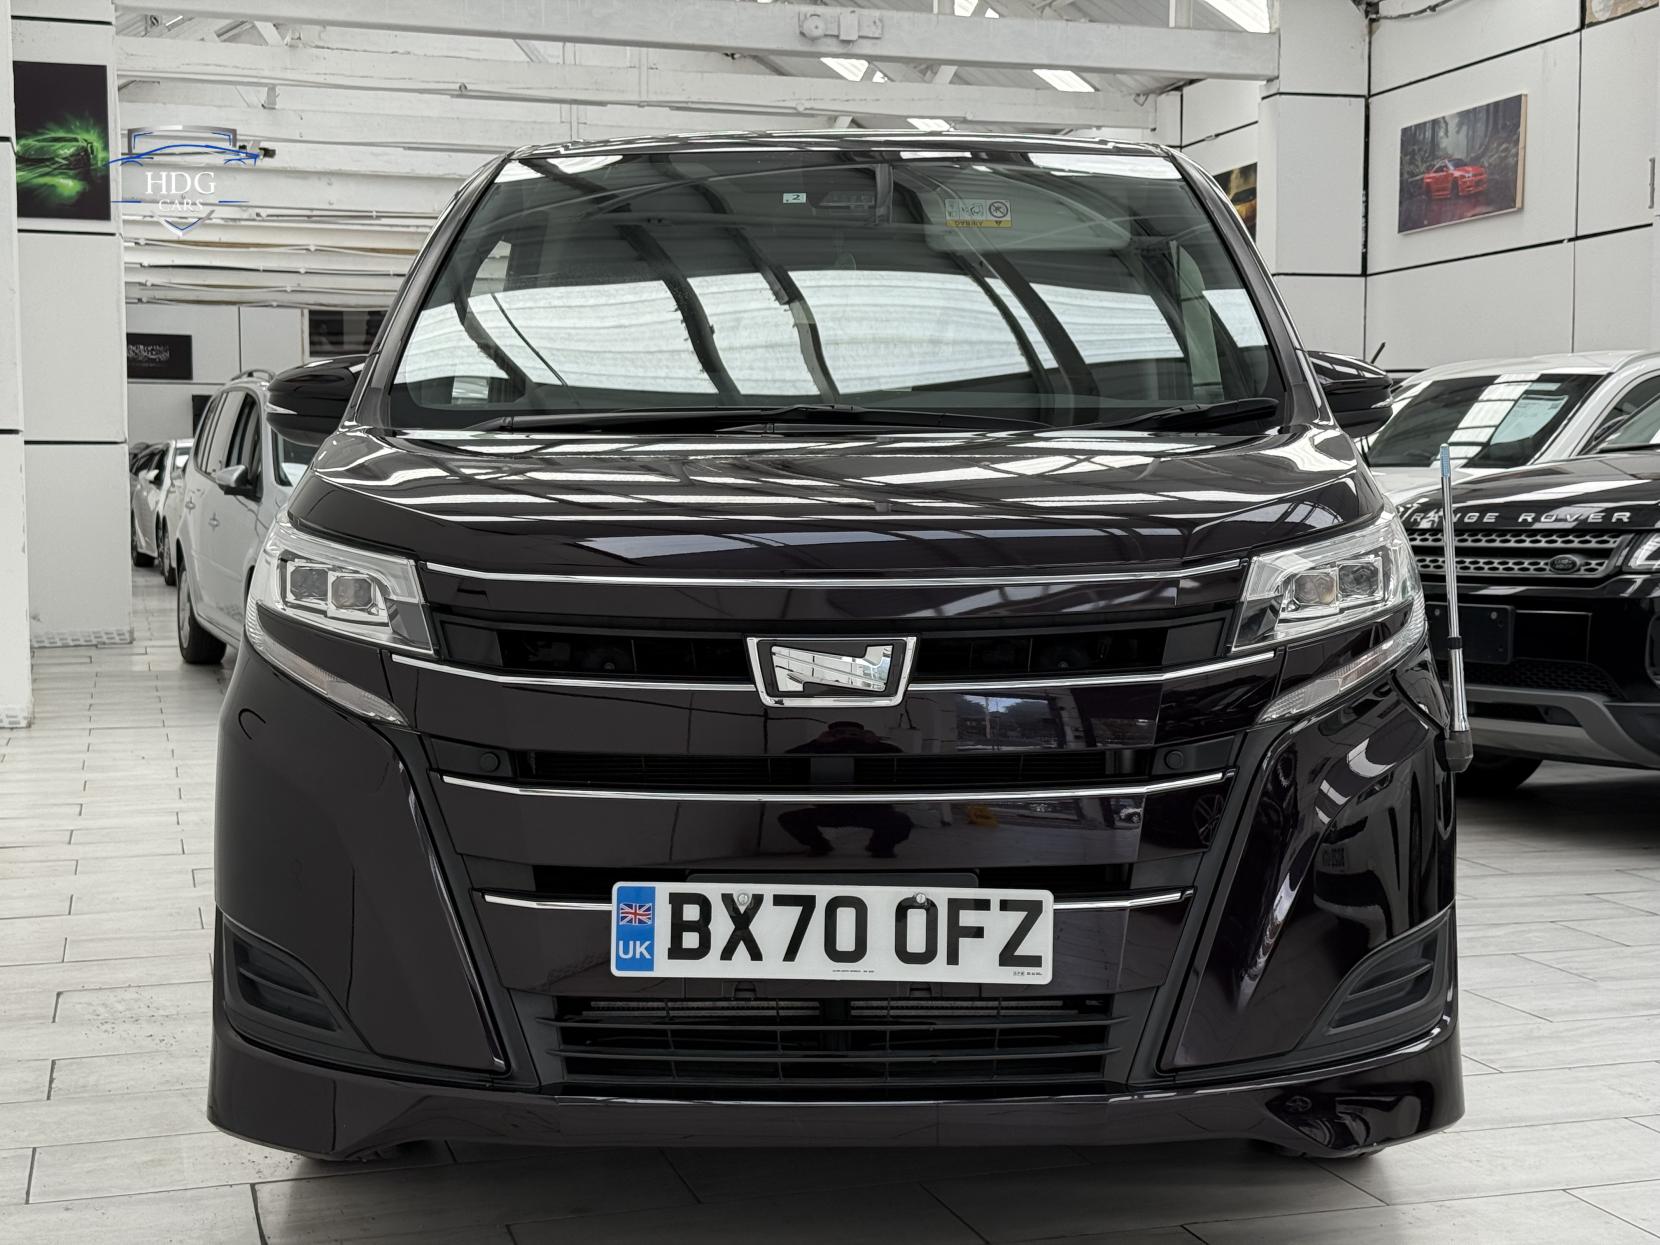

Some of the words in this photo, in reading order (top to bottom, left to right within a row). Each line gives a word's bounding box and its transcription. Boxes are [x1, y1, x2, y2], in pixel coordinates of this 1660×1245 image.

[1517, 512, 1631, 523] ROVER
[667, 892, 868, 963] BX70
[894, 896, 1043, 968] OFZ
[618, 940, 652, 959] UK
